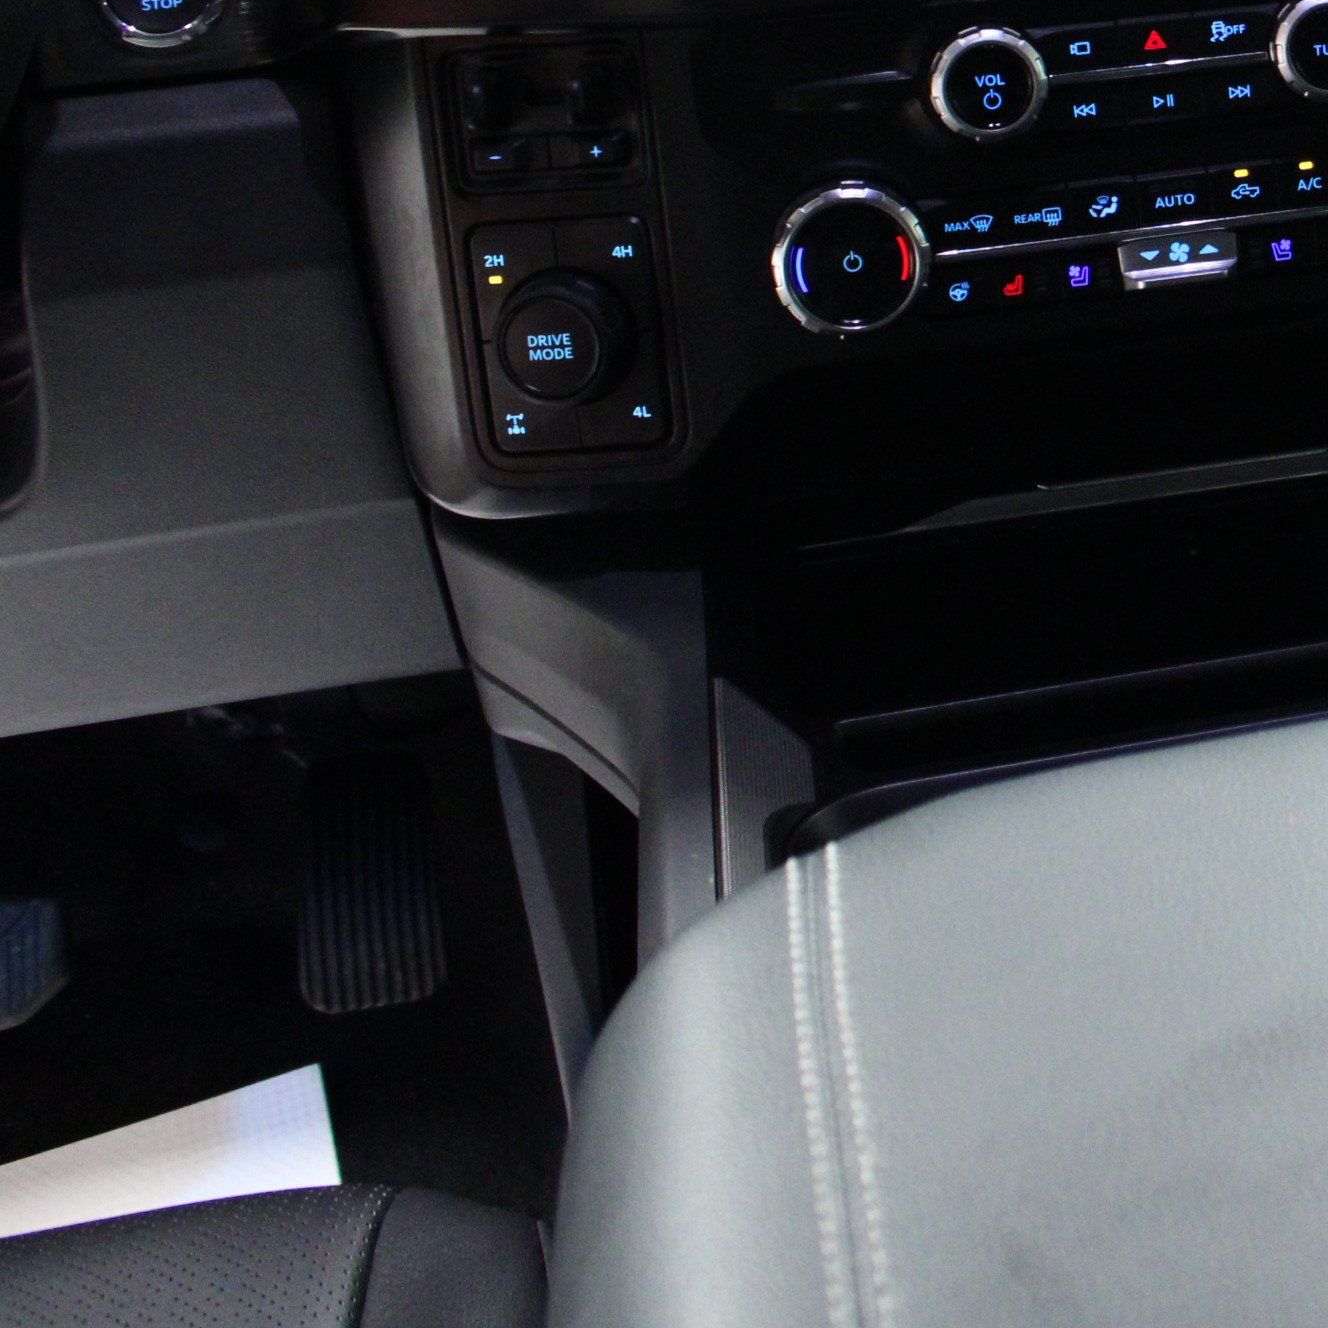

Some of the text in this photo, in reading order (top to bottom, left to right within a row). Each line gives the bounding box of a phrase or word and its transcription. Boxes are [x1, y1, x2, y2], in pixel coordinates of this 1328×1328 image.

[1226, 23, 1246, 36] OFF
[975, 72, 1006, 88] VOL
[1297, 175, 1322, 192] A/C
[1154, 191, 1196, 209] AUTO
[1013, 211, 1041, 225] REAR
[944, 220, 970, 234] MAX
[611, 243, 633, 259] 4H
[484, 254, 505, 269] 2H
[527, 332, 572, 348] DRIVE
[528, 345, 575, 361] MODE
[632, 404, 652, 419] 4L
